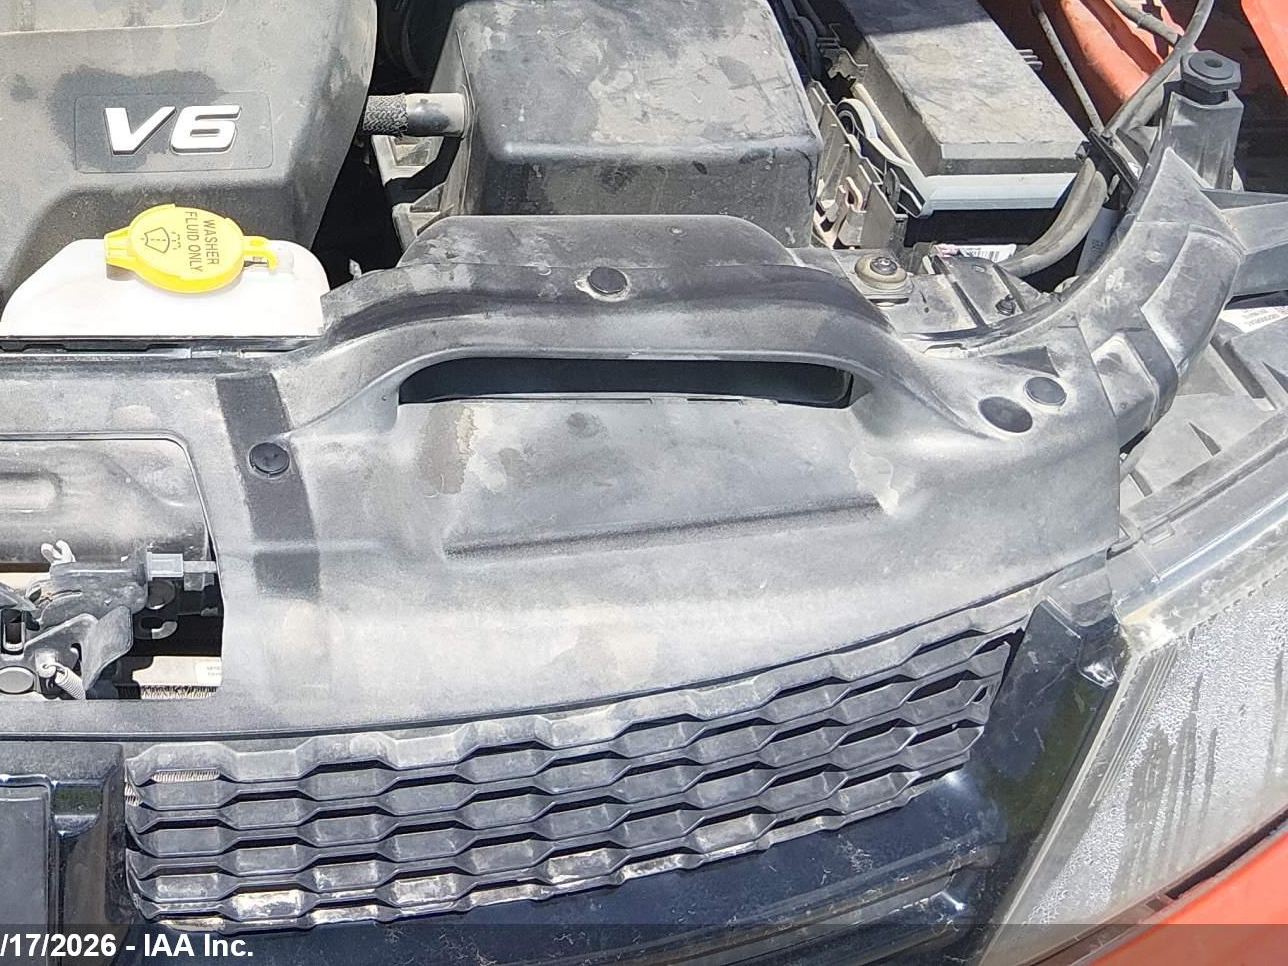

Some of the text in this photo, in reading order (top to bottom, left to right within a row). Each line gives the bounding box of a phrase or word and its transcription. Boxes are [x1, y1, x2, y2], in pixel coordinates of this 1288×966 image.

[103, 105, 242, 156] V6
[185, 211, 204, 273] FLUID ONLY
[203, 219, 220, 266] WASHER
